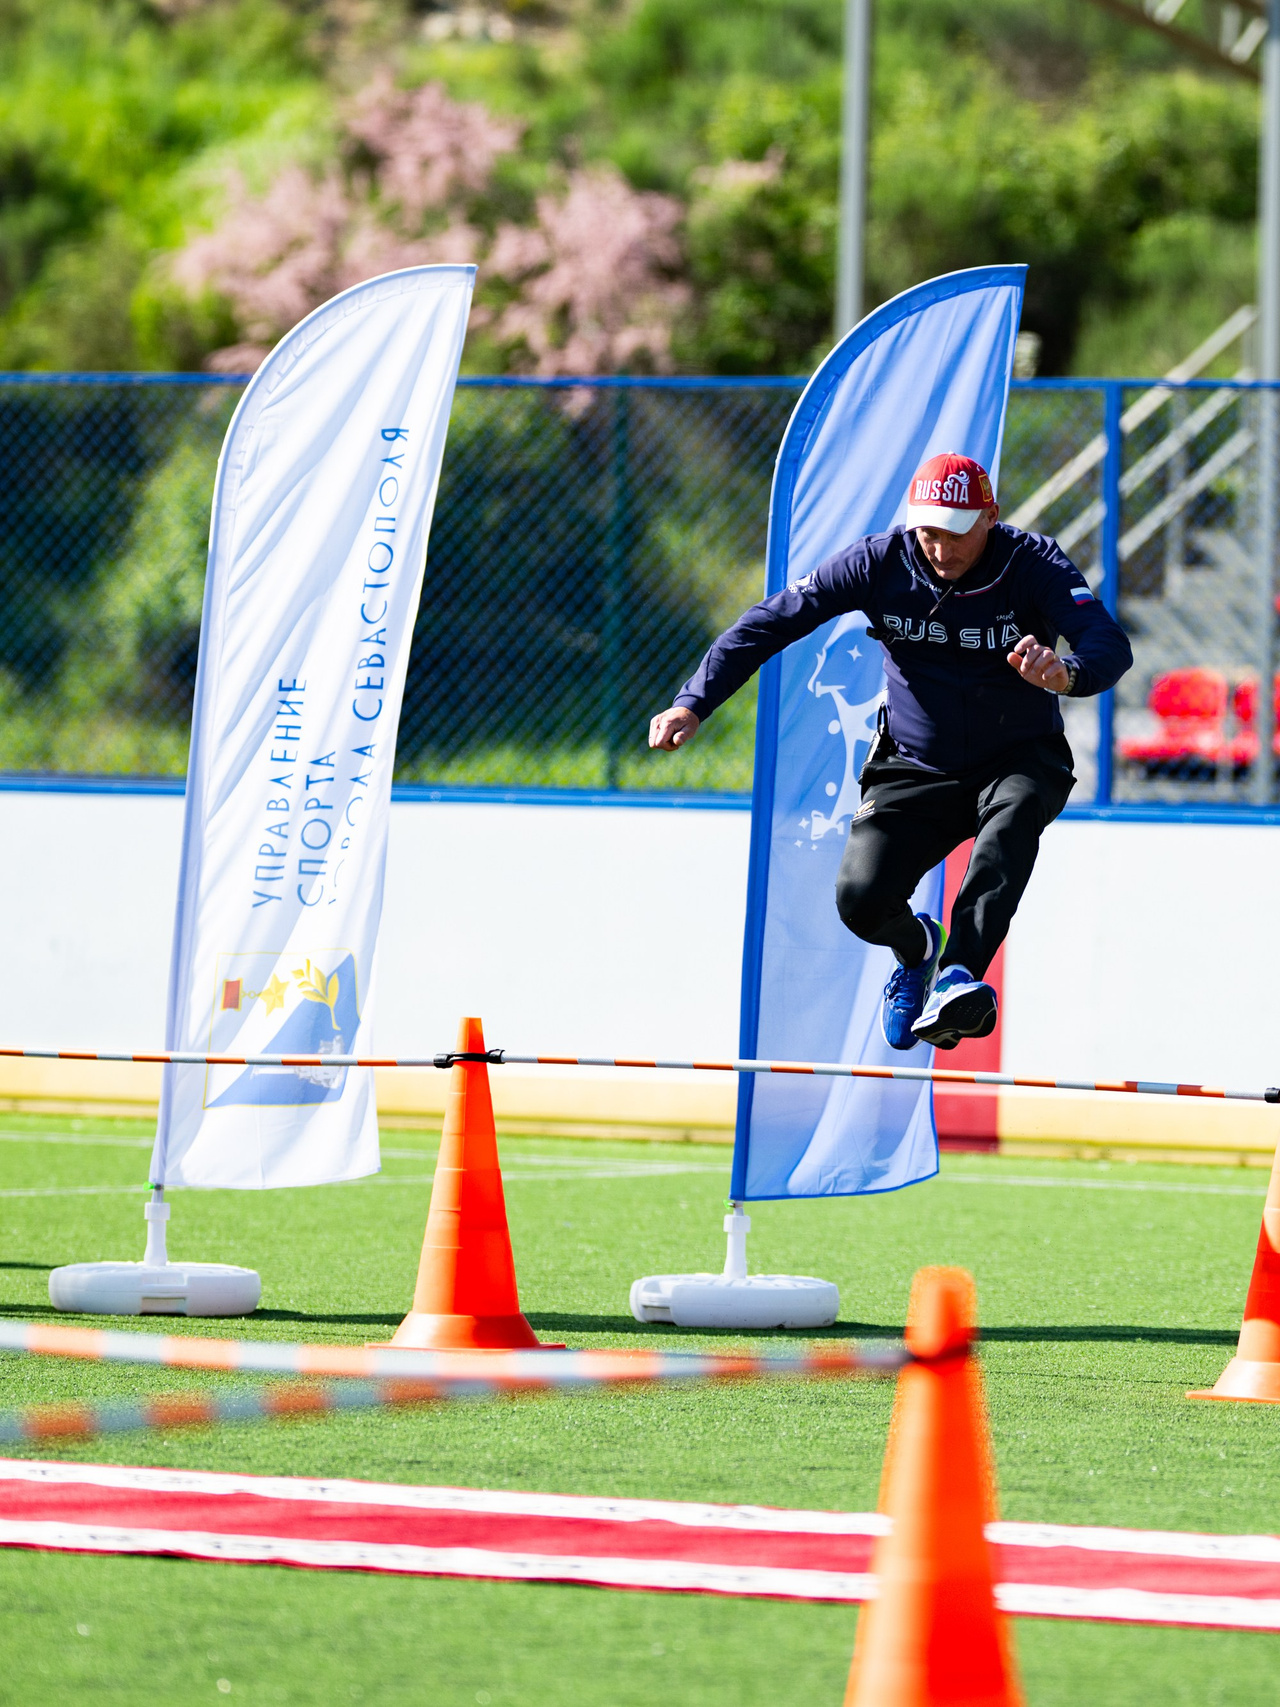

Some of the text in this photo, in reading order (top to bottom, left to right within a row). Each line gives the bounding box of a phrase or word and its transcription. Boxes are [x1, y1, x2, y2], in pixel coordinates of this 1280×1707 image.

[914, 479, 970, 504] RUSSIA
[352, 427, 409, 723] СЕВАСТОПОЛЯ
[876, 613, 1023, 650] RUSSIA
[252, 678, 307, 908] УПРАВЛЕНИЕ
[297, 750, 336, 907] СПОРТА
